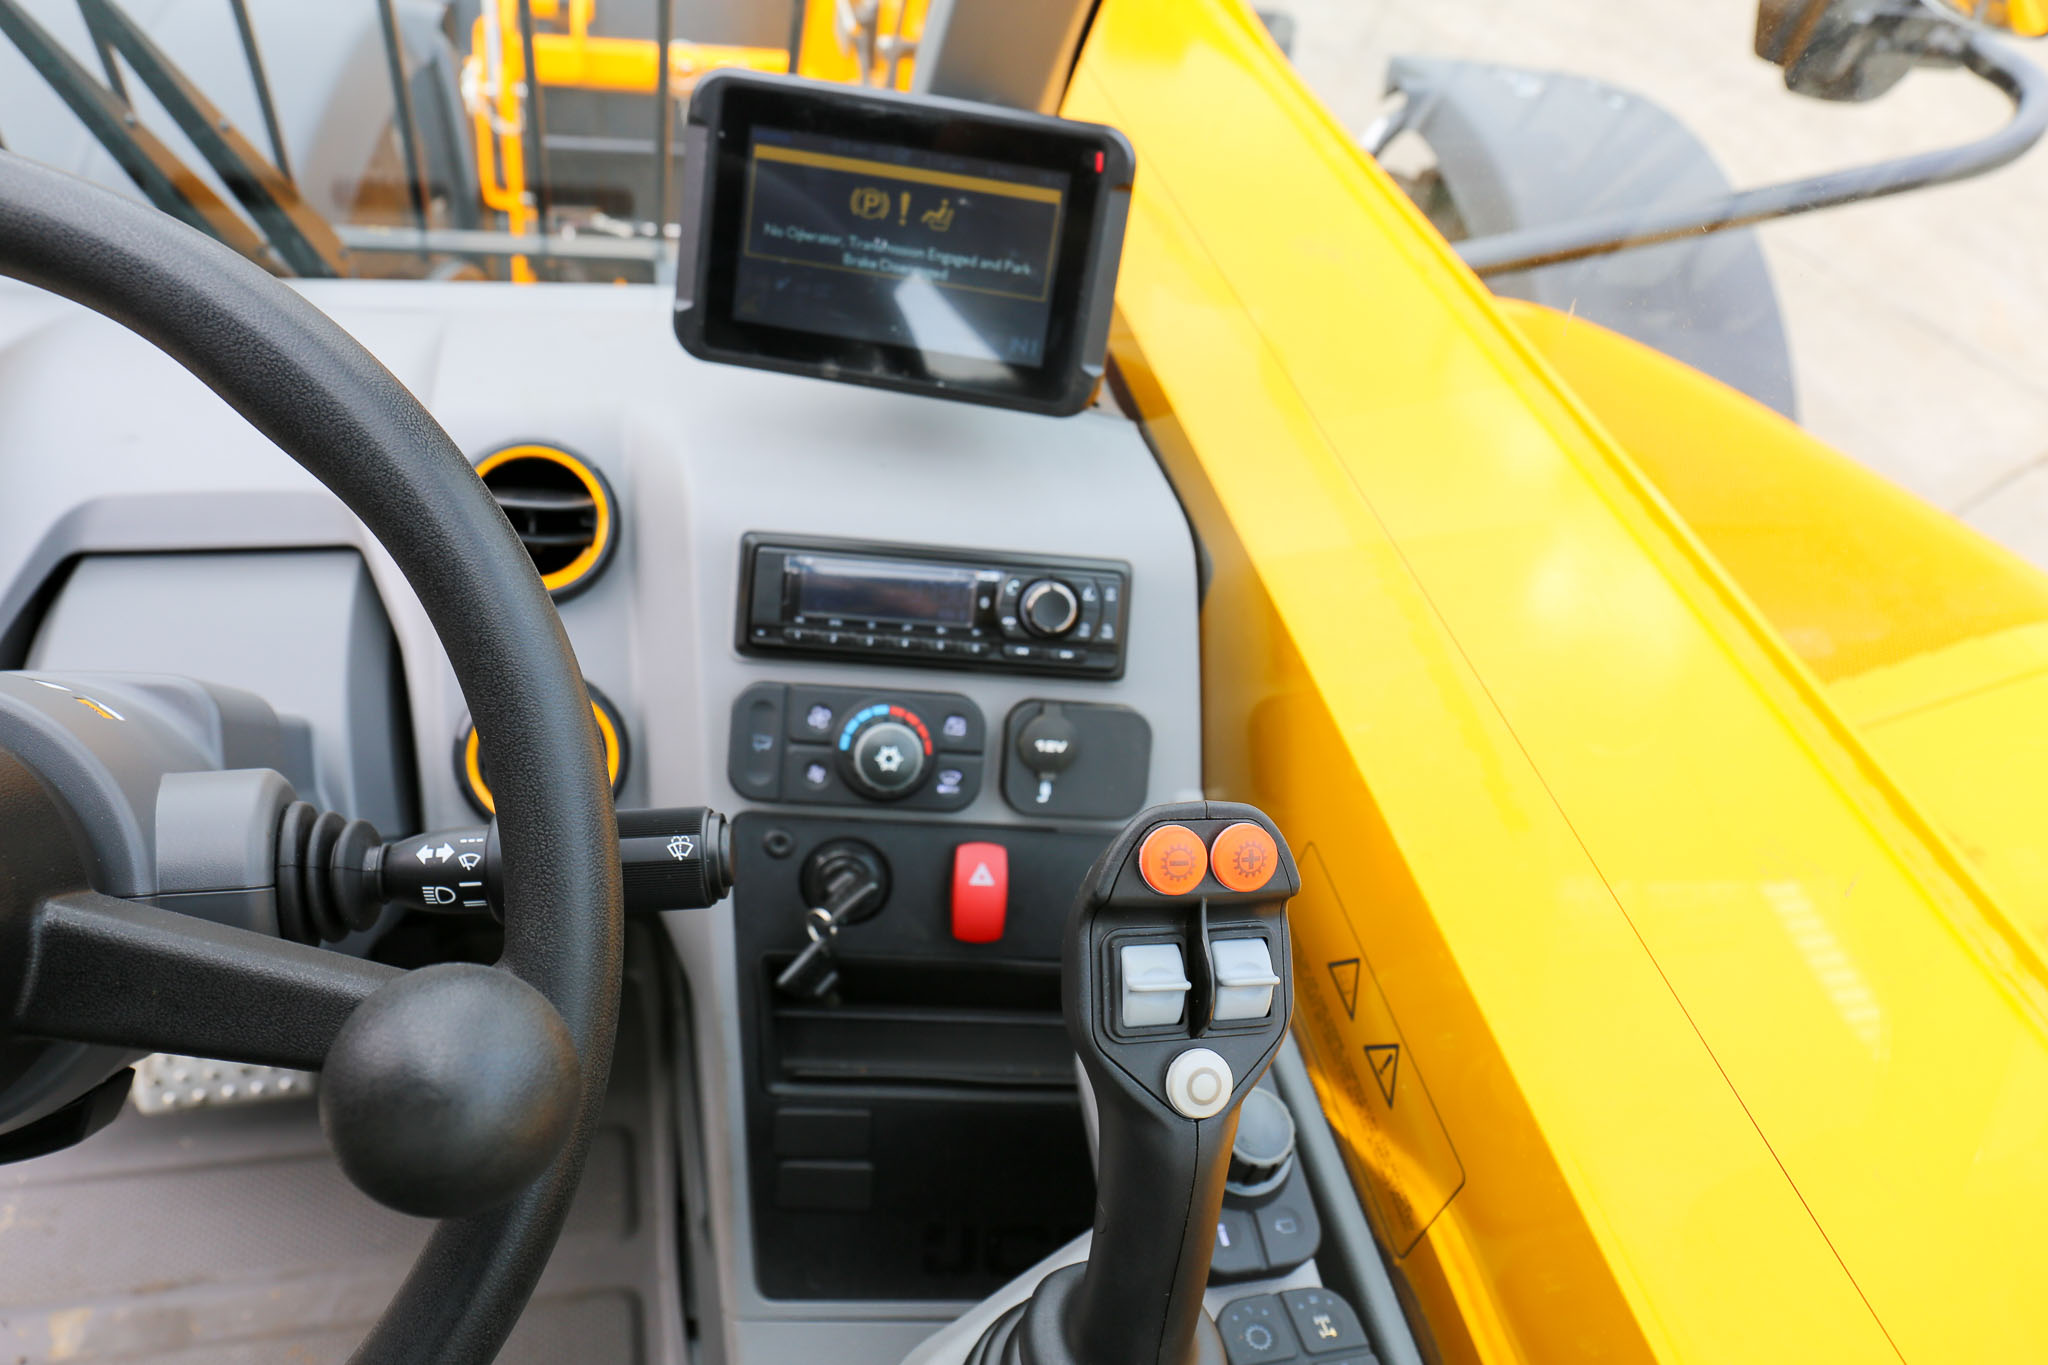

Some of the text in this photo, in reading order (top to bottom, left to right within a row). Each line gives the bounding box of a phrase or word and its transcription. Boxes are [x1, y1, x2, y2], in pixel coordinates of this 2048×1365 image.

[763, 223, 784, 239] No
[927, 246, 978, 269] Engaged
[980, 256, 1002, 273] and
[1004, 258, 1031, 276] Park
[842, 252, 877, 270] Brake
